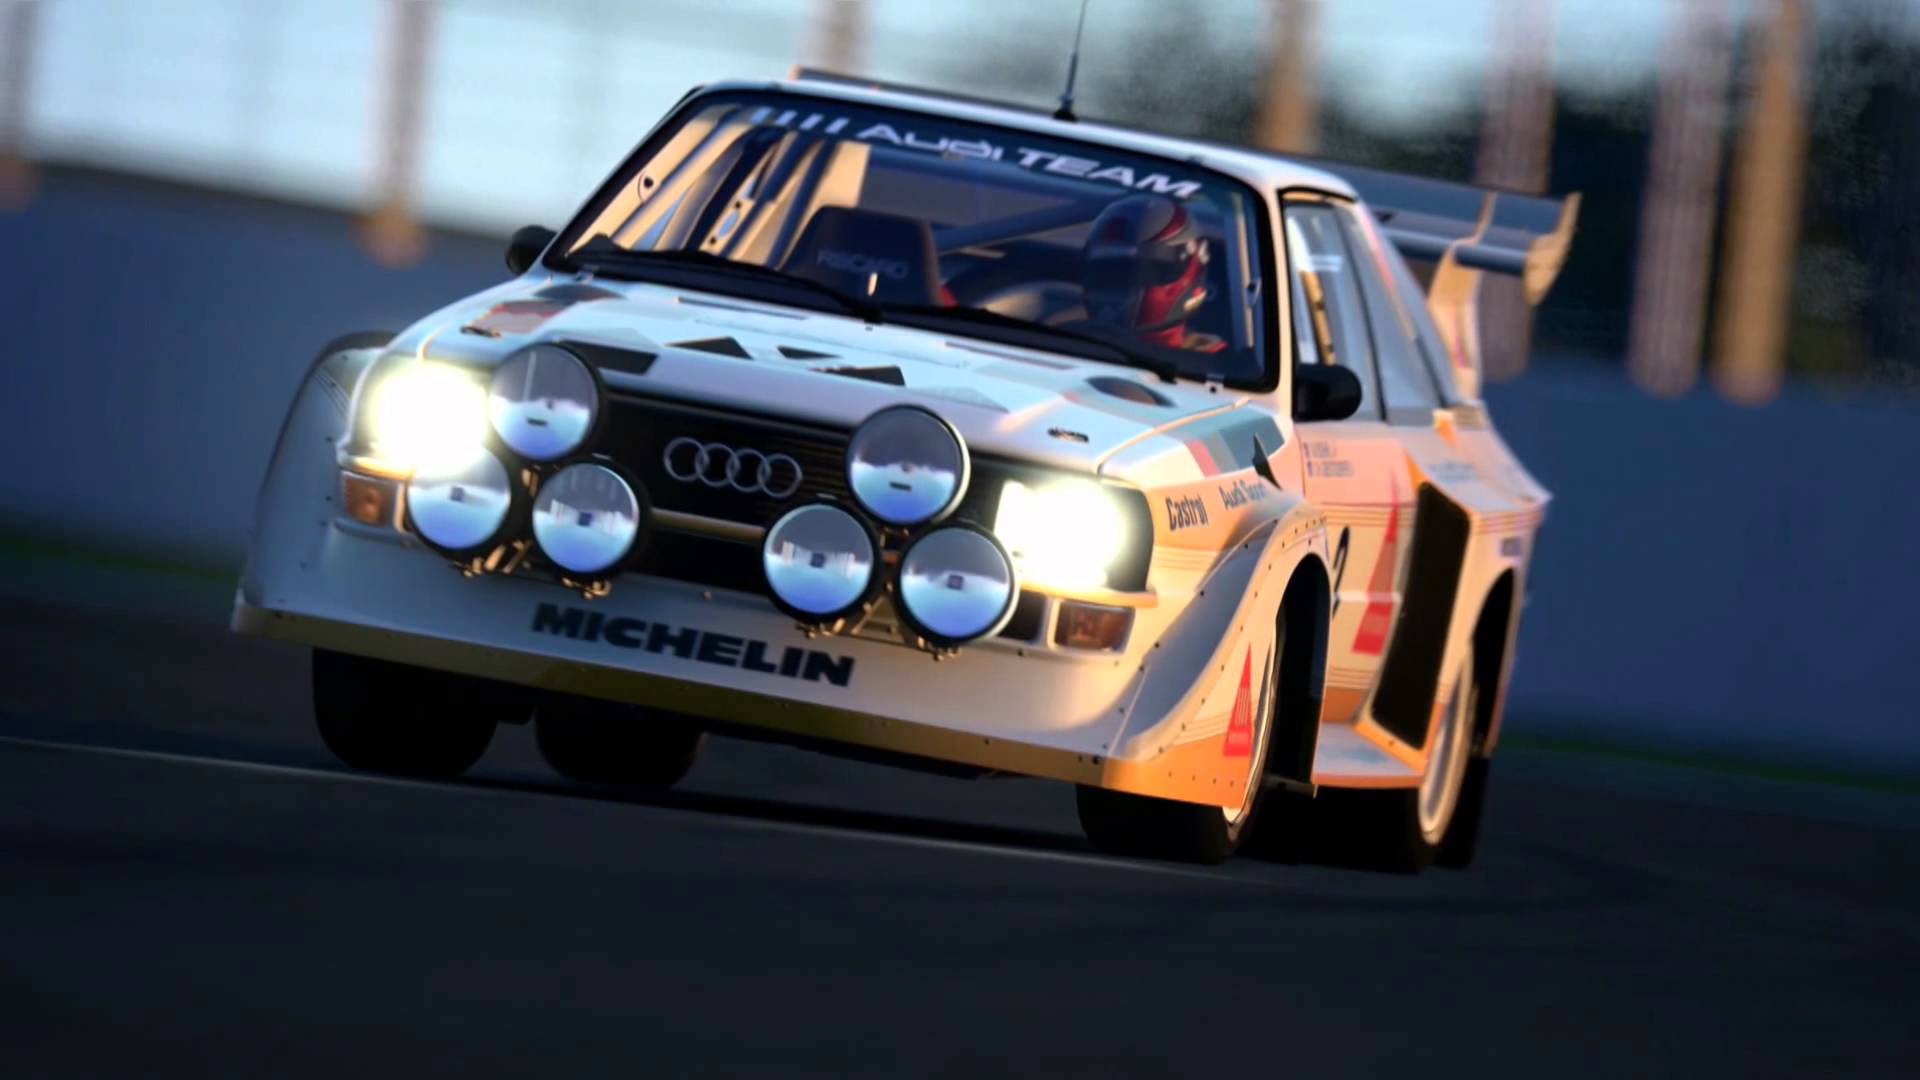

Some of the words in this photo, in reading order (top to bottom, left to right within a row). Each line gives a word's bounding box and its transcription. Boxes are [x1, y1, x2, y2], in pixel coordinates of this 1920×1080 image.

[1017, 146, 1202, 198] TEAM
[1165, 495, 1208, 531] Castrol
[1218, 480, 1248, 510] Audi
[531, 602, 856, 687] MICHELIN
